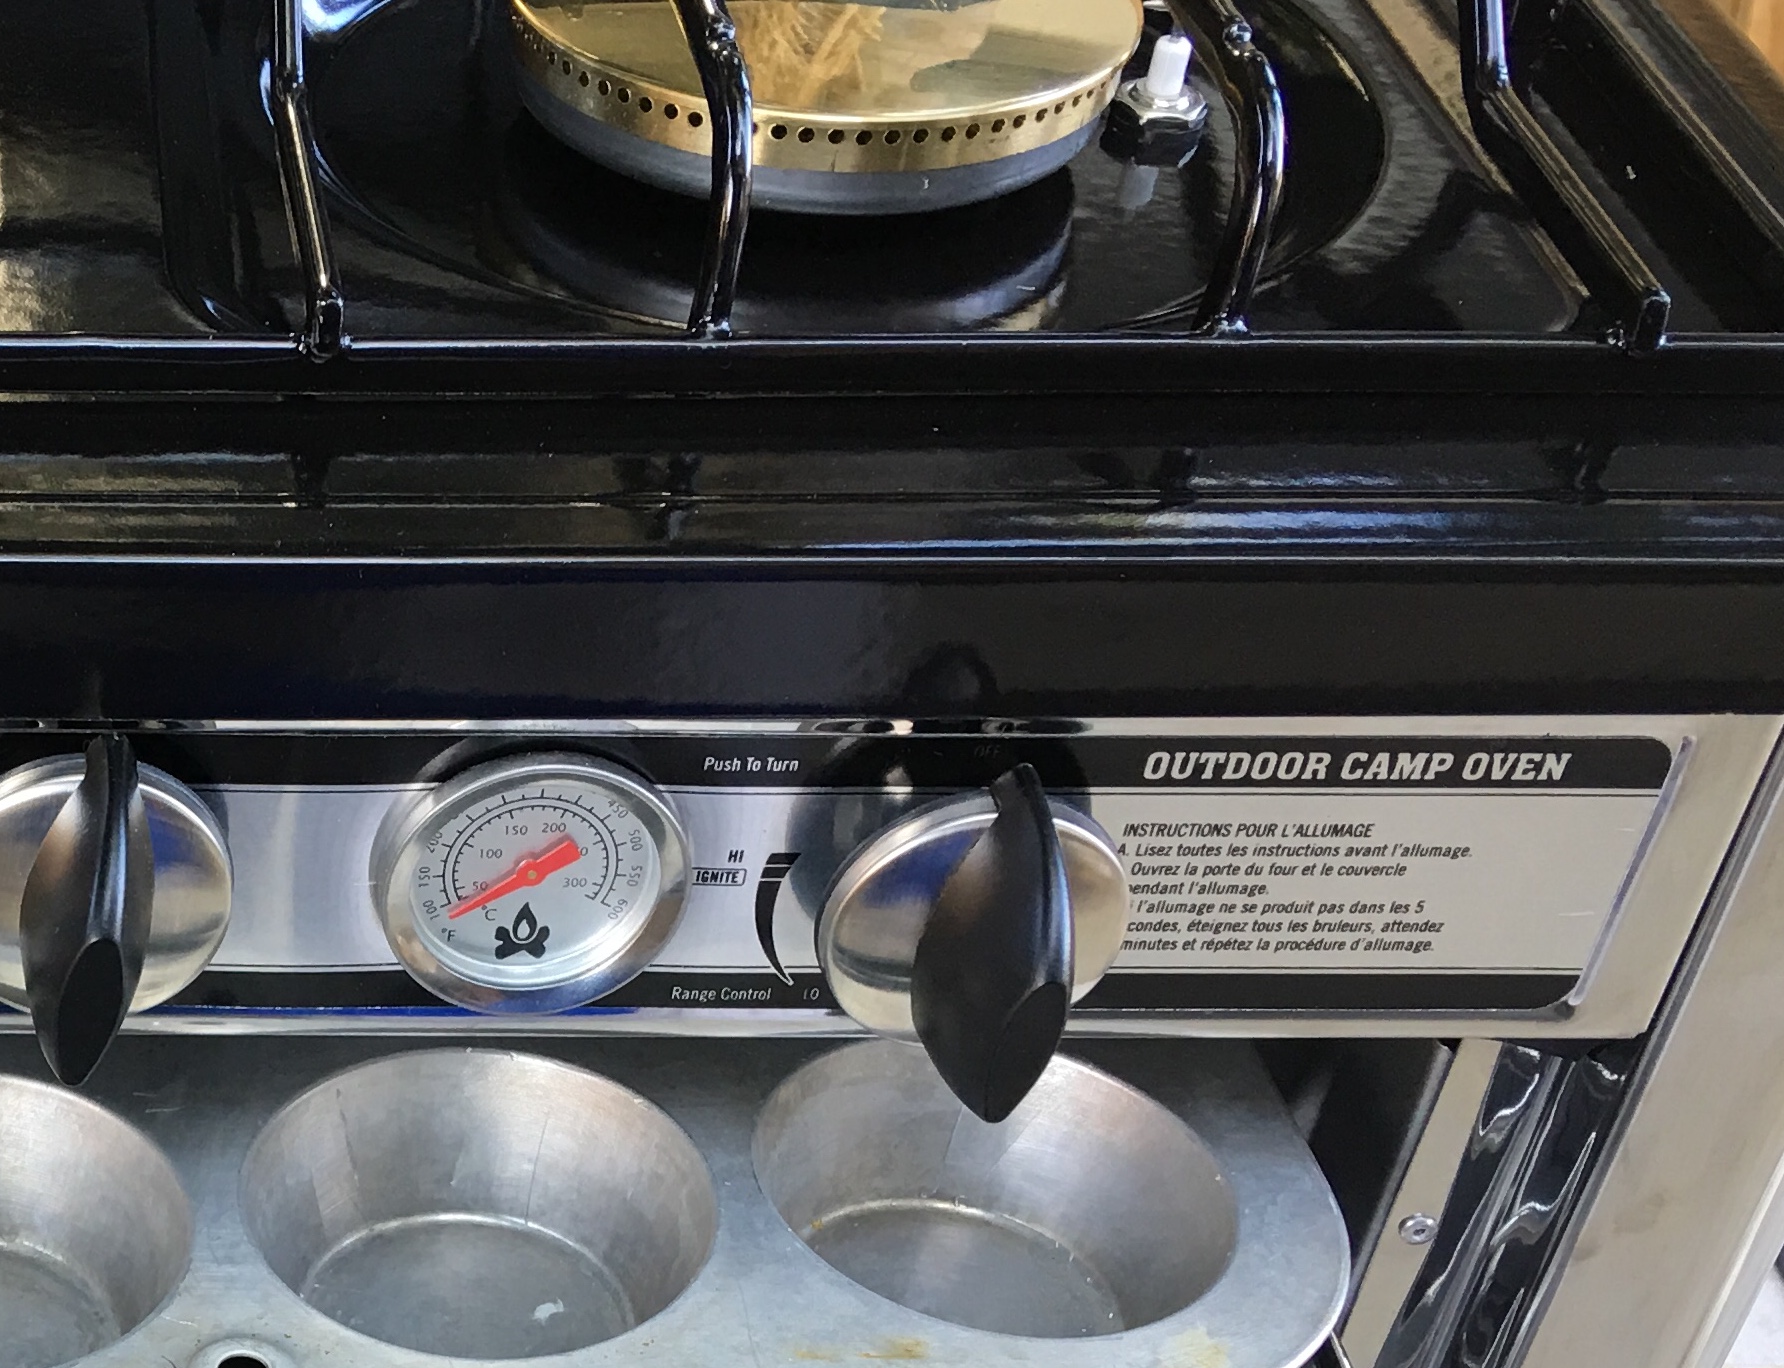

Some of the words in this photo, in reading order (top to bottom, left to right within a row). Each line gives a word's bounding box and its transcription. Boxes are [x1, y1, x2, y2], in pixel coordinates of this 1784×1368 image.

[703, 757, 742, 771] Push
[746, 757, 762, 771] To
[766, 757, 799, 772] Turn
[1143, 752, 1331, 781] OUTDOOR
[1340, 752, 1453, 781] CAMP
[1462, 752, 1571, 782] OVEN
[504, 825, 528, 836] 150
[542, 822, 567, 834] 200
[1122, 823, 1232, 837] INSTRUCTIONS
[1235, 823, 1278, 837] POUR
[1281, 823, 1375, 838] L'ALLUMAGE
[629, 829, 644, 852] 500
[479, 848, 503, 859] 100
[728, 850, 745, 863] HI
[1135, 843, 1172, 857] Lisez
[1176, 843, 1222, 857] toutes
[1227, 843, 1248, 857] les
[1252, 843, 1341, 857] instructions
[1344, 844, 1388, 857] avant
[419, 866, 431, 888] 150
[627, 865, 643, 887] 550
[695, 870, 741, 884] IGNITE
[1131, 862, 1181, 876] Ouvrez
[1184, 862, 1198, 876] la
[1202, 863, 1241, 878] porte
[1244, 862, 1264, 876] du
[1268, 862, 1299, 876] four
[1301, 863, 1317, 876] et
[1320, 863, 1334, 876] le
[1337, 863, 1407, 876] couvercle
[472, 881, 488, 891] 50
[562, 877, 587, 888] 300
[422, 900, 441, 921] 100
[608, 898, 629, 920] 600
[1137, 900, 1215, 916] l'allumage
[1218, 902, 1237, 914] ne
[1240, 902, 1258, 914] se
[1260, 900, 1315, 916] produit
[1317, 902, 1345, 916] pas
[1349, 900, 1385, 914] dans
[1389, 900, 1411, 914] les
[1414, 900, 1425, 914] 5
[1186, 919, 1248, 935] éteignez
[1251, 919, 1287, 933] tous
[1287, 919, 1308, 933] les
[1312, 919, 1375, 935] bruleurs,
[1380, 919, 1445, 933] attendez
[1120, 938, 1178, 951] minutes
[1182, 938, 1197, 951] et
[1200, 937, 1253, 953] répétez
[1256, 938, 1271, 951] la
[1274, 938, 1346, 953] procédure
[671, 987, 716, 1002] Range
[720, 987, 772, 1001] Control
